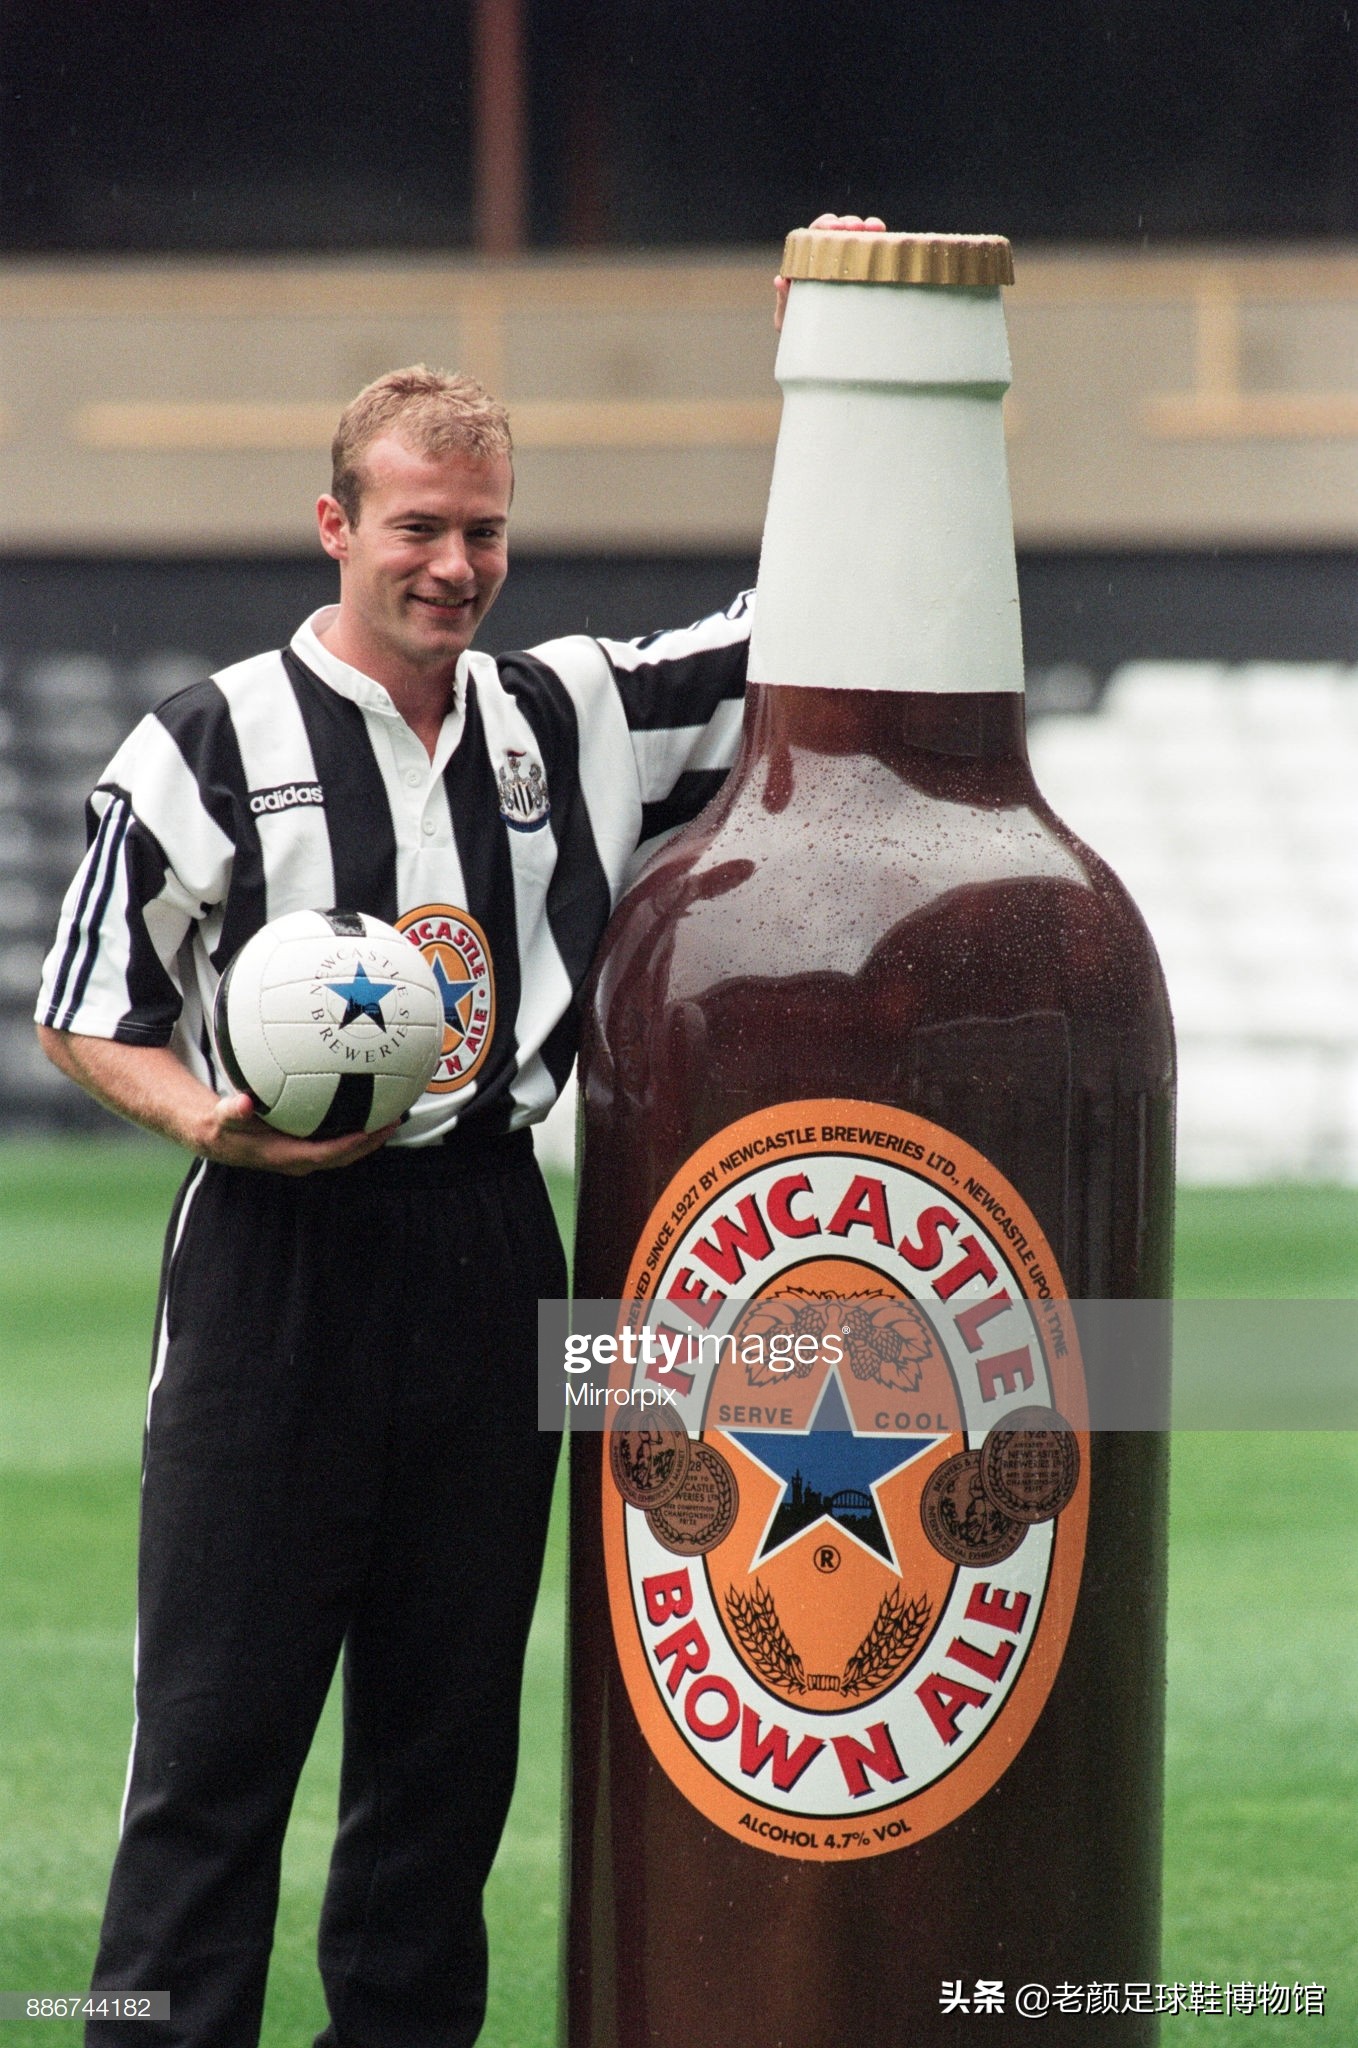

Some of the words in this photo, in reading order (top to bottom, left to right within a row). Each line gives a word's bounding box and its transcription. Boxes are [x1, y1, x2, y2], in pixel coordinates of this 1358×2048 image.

[249, 785, 324, 813] adidas
[310, 947, 409, 998] NEWCASTLE
[311, 1007, 410, 1064] BREWERIES
[465, 1007, 488, 1055] ALE
[624, 1271, 651, 1338] REWED
[646, 1221, 675, 1271] SINCE
[671, 1185, 700, 1226] 1927
[698, 1166, 720, 1193] BY
[719, 1126, 817, 1175] NEWCASTLE
[821, 1126, 926, 1161] BREWERIES
[963, 1177, 1035, 1267] NEWCASTLE
[1028, 1263, 1056, 1313] UPON
[1048, 1312, 1068, 1360] TYNE
[645, 1172, 1036, 1404] NEWCASTLE
[719, 1405, 793, 1425] SERVE
[875, 1412, 949, 1430] COOL
[642, 1566, 909, 1799] BROWN
[914, 1581, 1032, 1747] ALE
[738, 1812, 819, 1849] ALCOHOL
[824, 1829, 870, 1849] 4.7%
[872, 1818, 912, 1844] VOL
